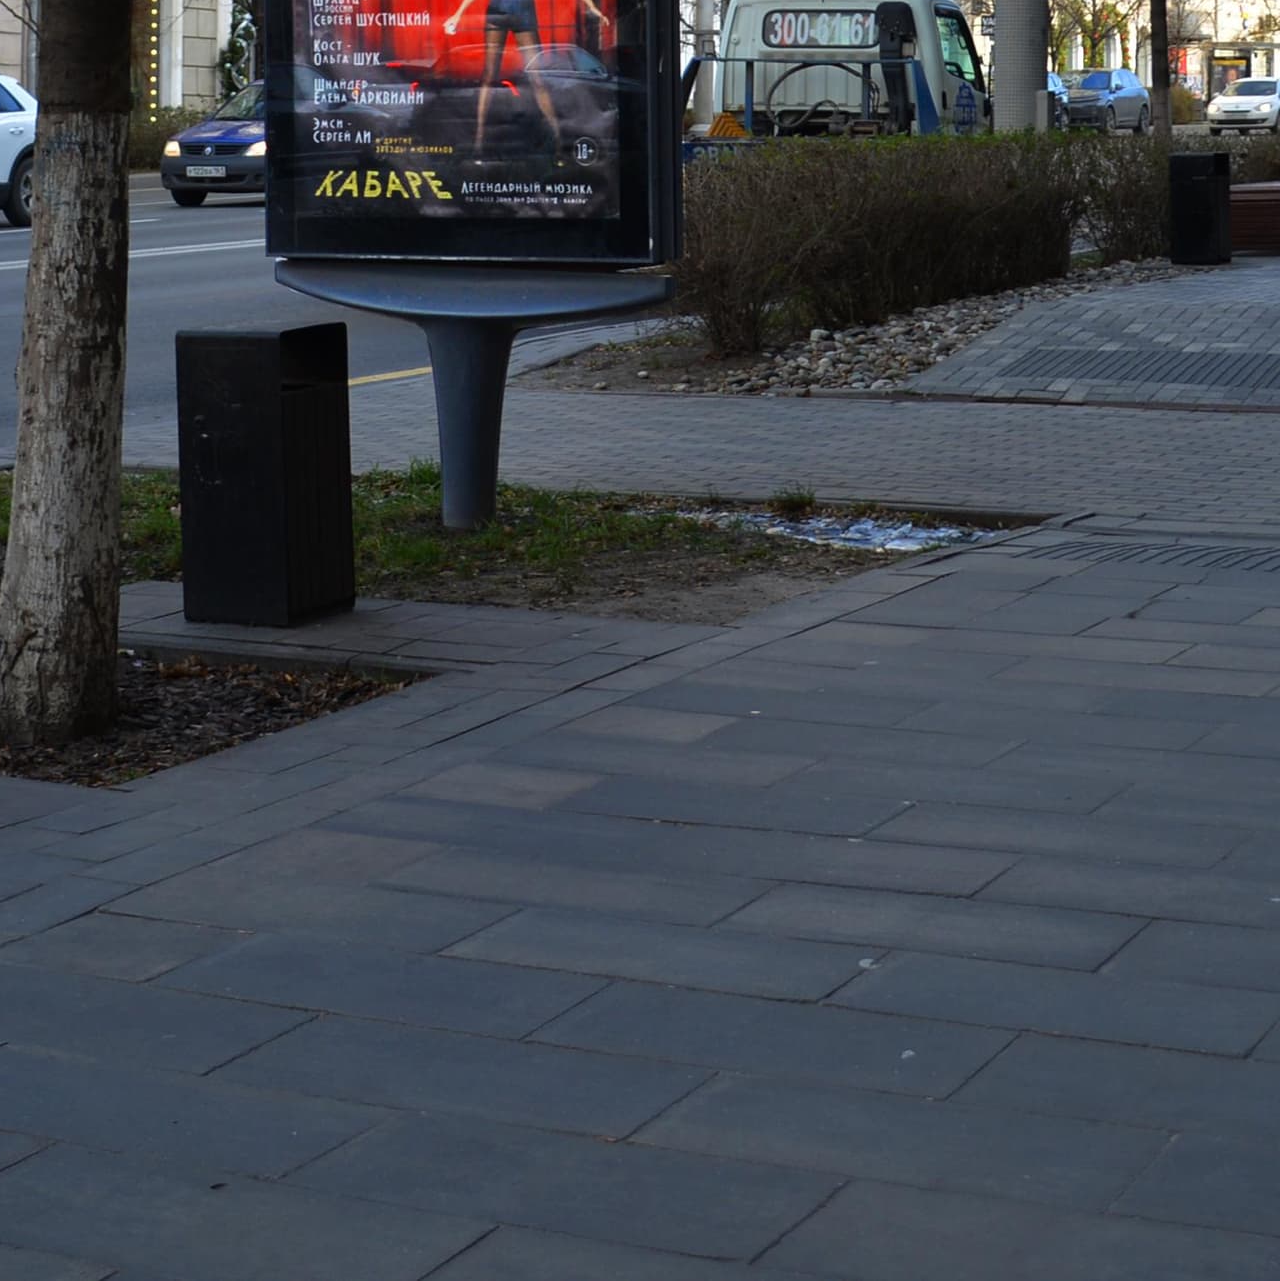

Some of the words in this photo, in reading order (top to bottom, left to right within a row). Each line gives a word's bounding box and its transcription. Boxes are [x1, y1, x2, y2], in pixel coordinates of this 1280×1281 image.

[313, 14, 352, 27] СЕРГЕЙ
[356, 10, 430, 27] ШУСТИЦКИЙ
[313, 39, 342, 52] КОСТ
[314, 53, 349, 66] ОЛЬГА
[353, 52, 381, 66] ШУК
[314, 78, 368, 92] ШНАЙДЕР
[314, 92, 348, 105] ЕЛЕНА
[352, 91, 424, 105] ЧАРКВИАНИ
[313, 117, 343, 130] ЭМСИ
[313, 130, 351, 143] СЕРГЕЙ
[355, 131, 371, 144] ЛИ
[577, 143, 595, 160] 18+
[314, 170, 453, 200] КАБАРЕ
[461, 181, 541, 194] ЛЕГЕНДАРНЫЙ
[545, 183, 593, 195] МЮЗИКЛ
